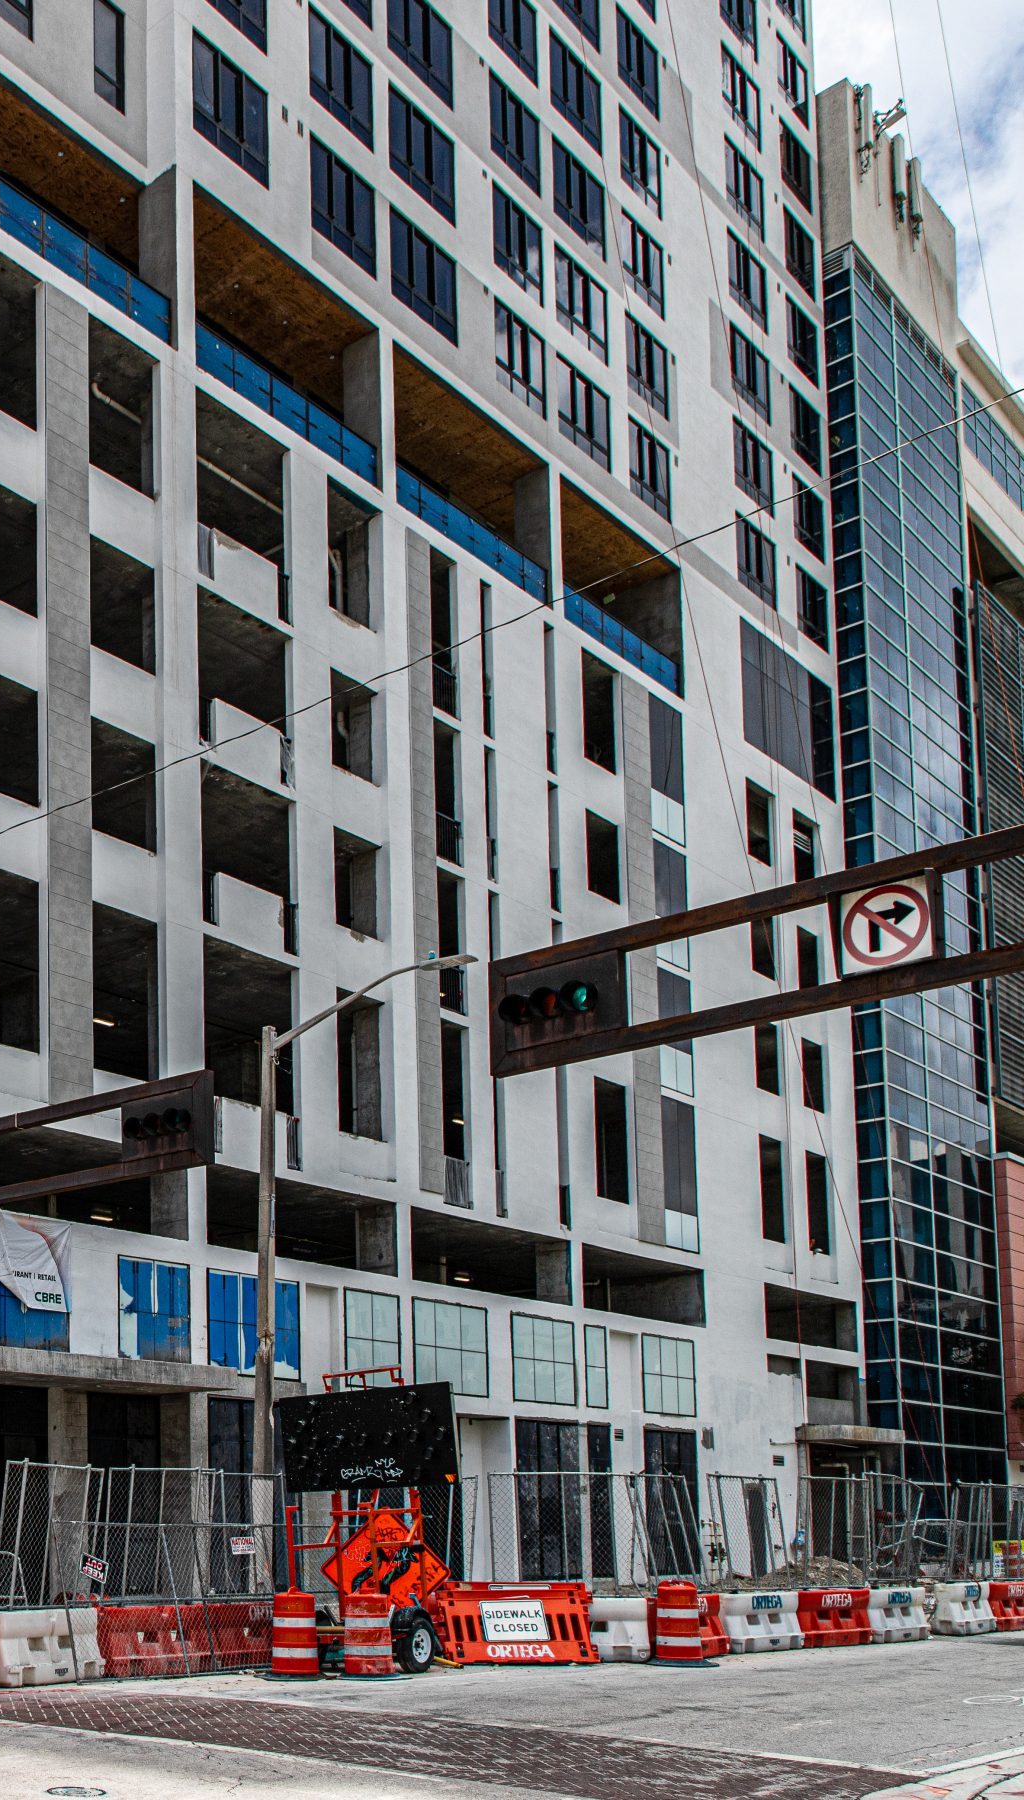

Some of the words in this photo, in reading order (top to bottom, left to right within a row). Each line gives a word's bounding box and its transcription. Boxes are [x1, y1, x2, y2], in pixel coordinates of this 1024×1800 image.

[37, 1273, 56, 1282] RETAIL
[34, 1291, 62, 1304] CBRE
[231, 1537, 255, 1546] NATIONAL
[85, 1557, 103, 1571] OUT
[82, 1565, 105, 1581] KEEP
[751, 1595, 783, 1610] ORTEGA
[821, 1593, 853, 1608] ORTEGA
[484, 1609, 542, 1620] SIDEWALK
[493, 1623, 539, 1633] CLOSED
[486, 1644, 556, 1658] ORTEGA
